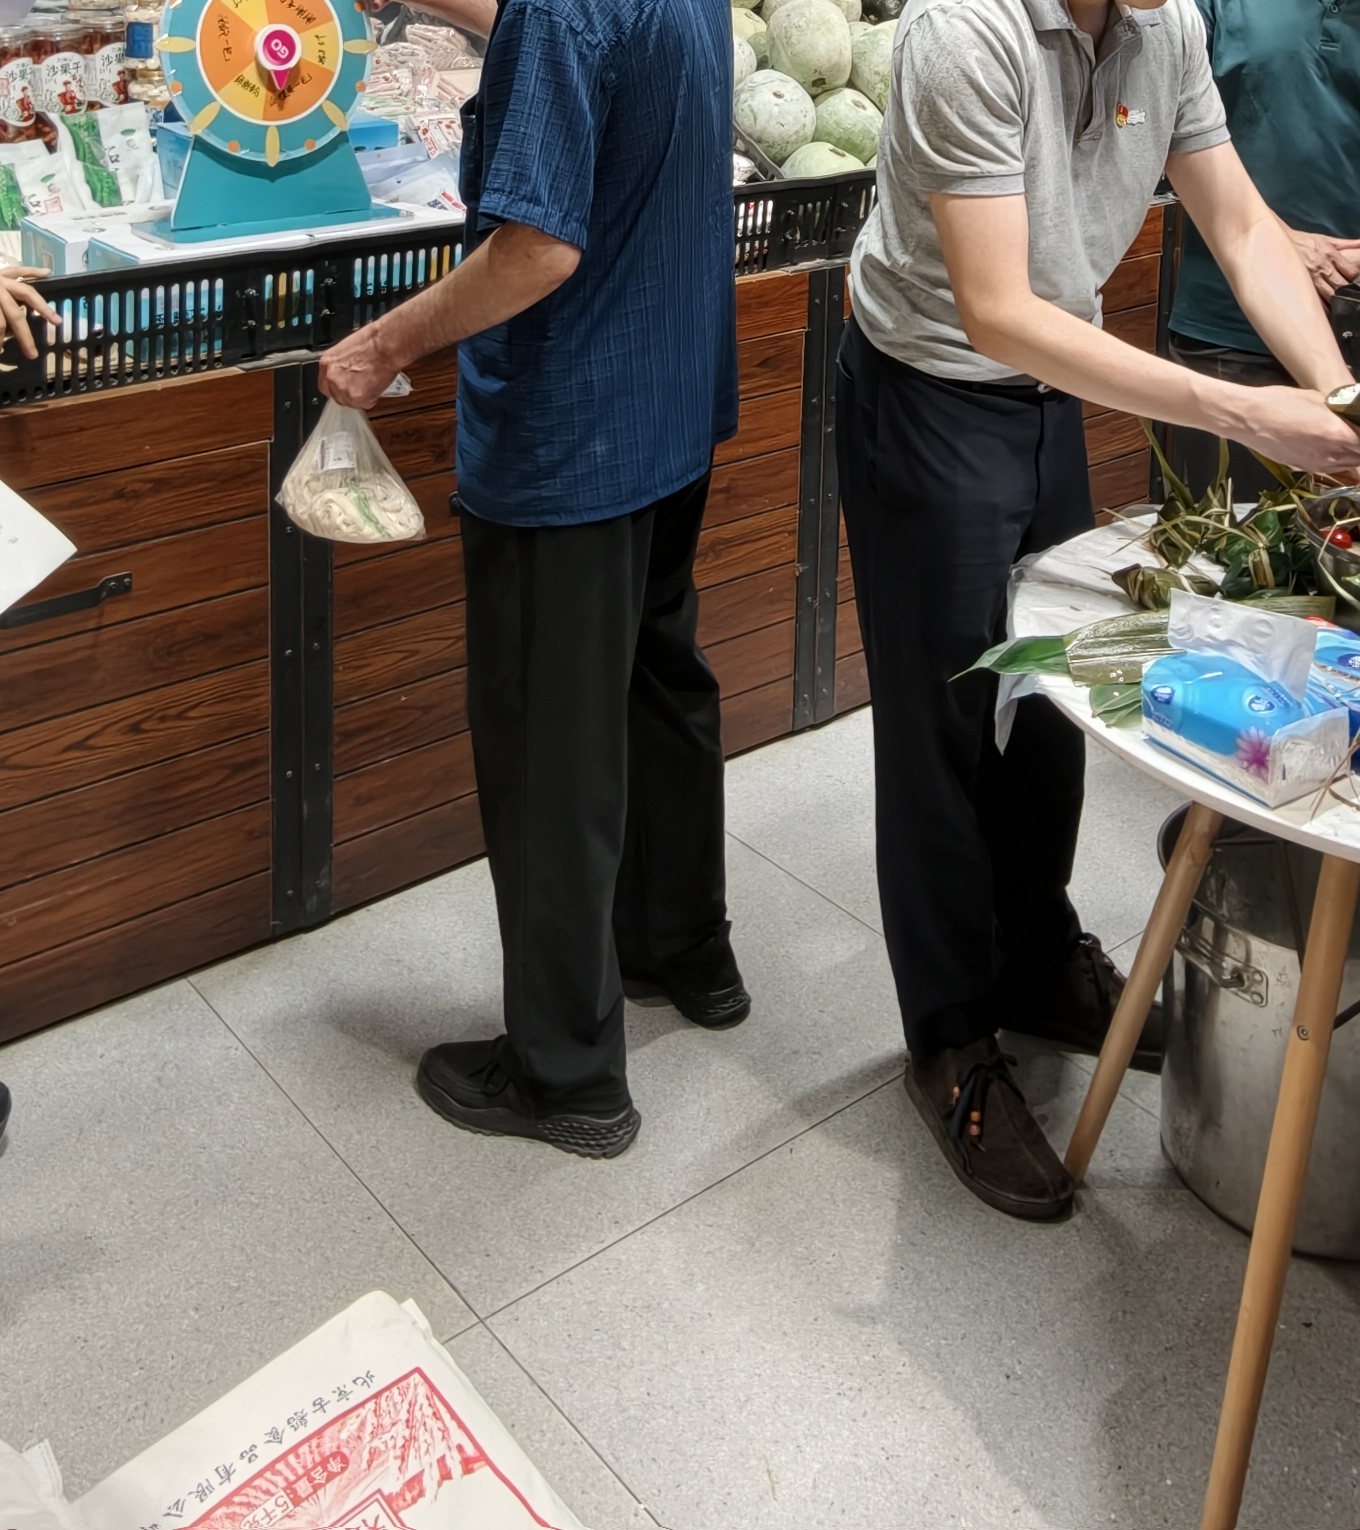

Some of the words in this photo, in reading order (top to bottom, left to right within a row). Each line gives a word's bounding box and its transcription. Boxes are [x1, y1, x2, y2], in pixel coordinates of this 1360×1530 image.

[271, 38, 290, 60] GO
[46, 60, 82, 78] 沙果干
